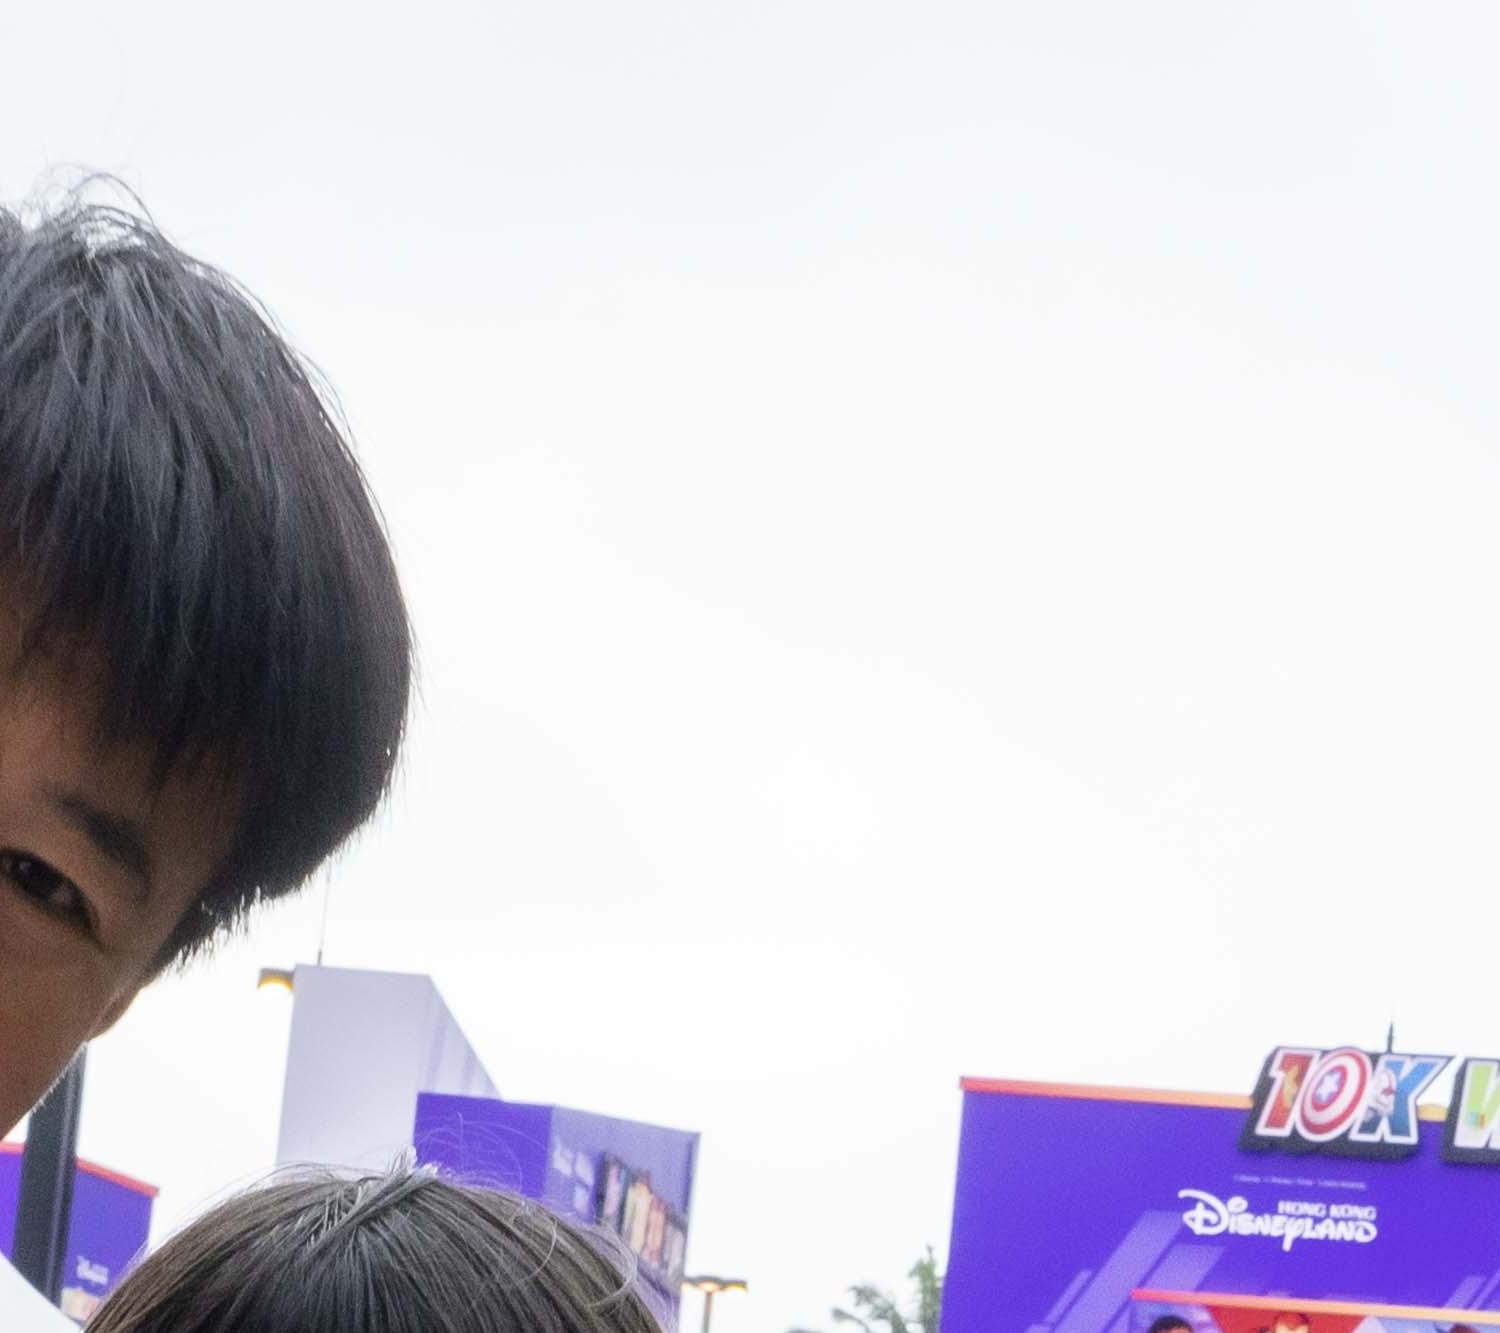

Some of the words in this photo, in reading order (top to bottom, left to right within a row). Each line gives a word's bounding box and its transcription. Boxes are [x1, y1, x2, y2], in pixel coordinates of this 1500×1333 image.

[1248, 1046, 1452, 1152] 10K
[1278, 1199, 1327, 1218] HONG
[1330, 1203, 1378, 1222] KONG
